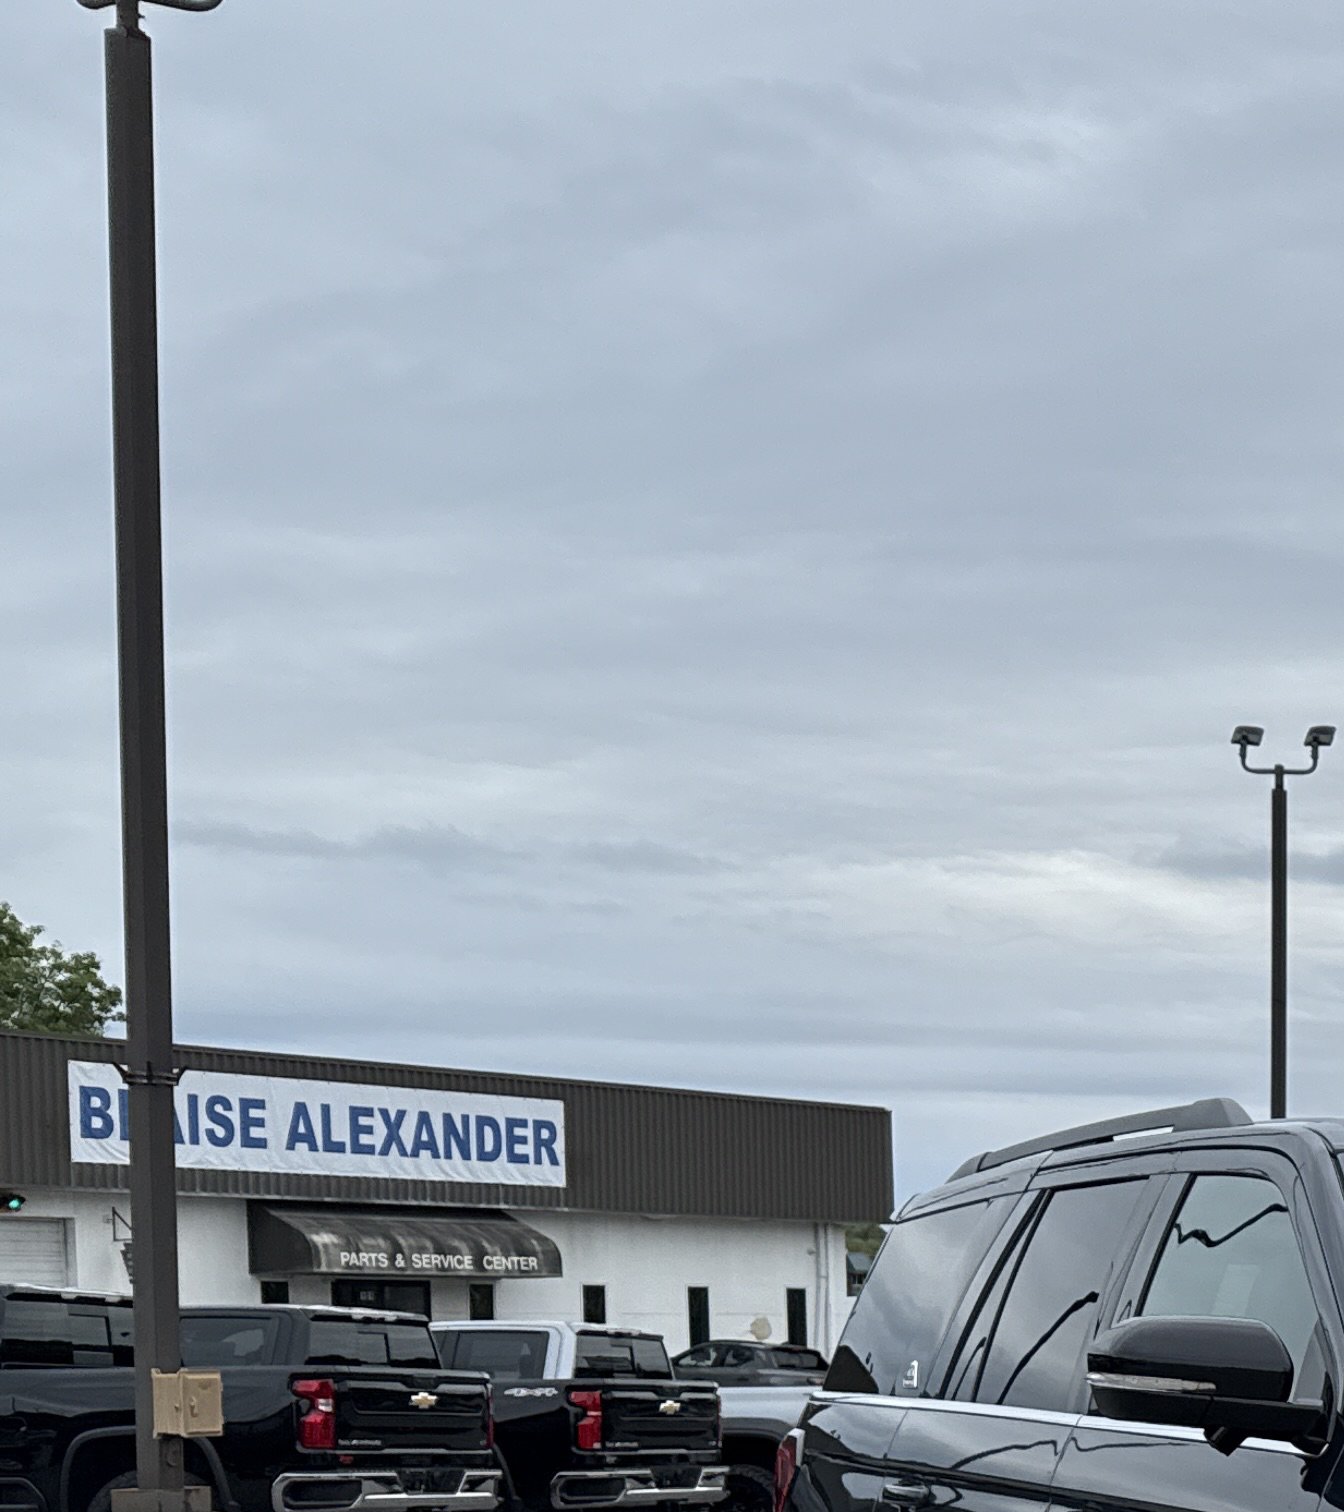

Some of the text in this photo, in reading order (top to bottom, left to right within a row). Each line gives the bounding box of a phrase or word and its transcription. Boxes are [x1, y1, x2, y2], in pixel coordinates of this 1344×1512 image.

[79, 1085, 560, 1167] BLISE ALEXANDER
[340, 1251, 538, 1271] PARTS & SERVICE CENTER
